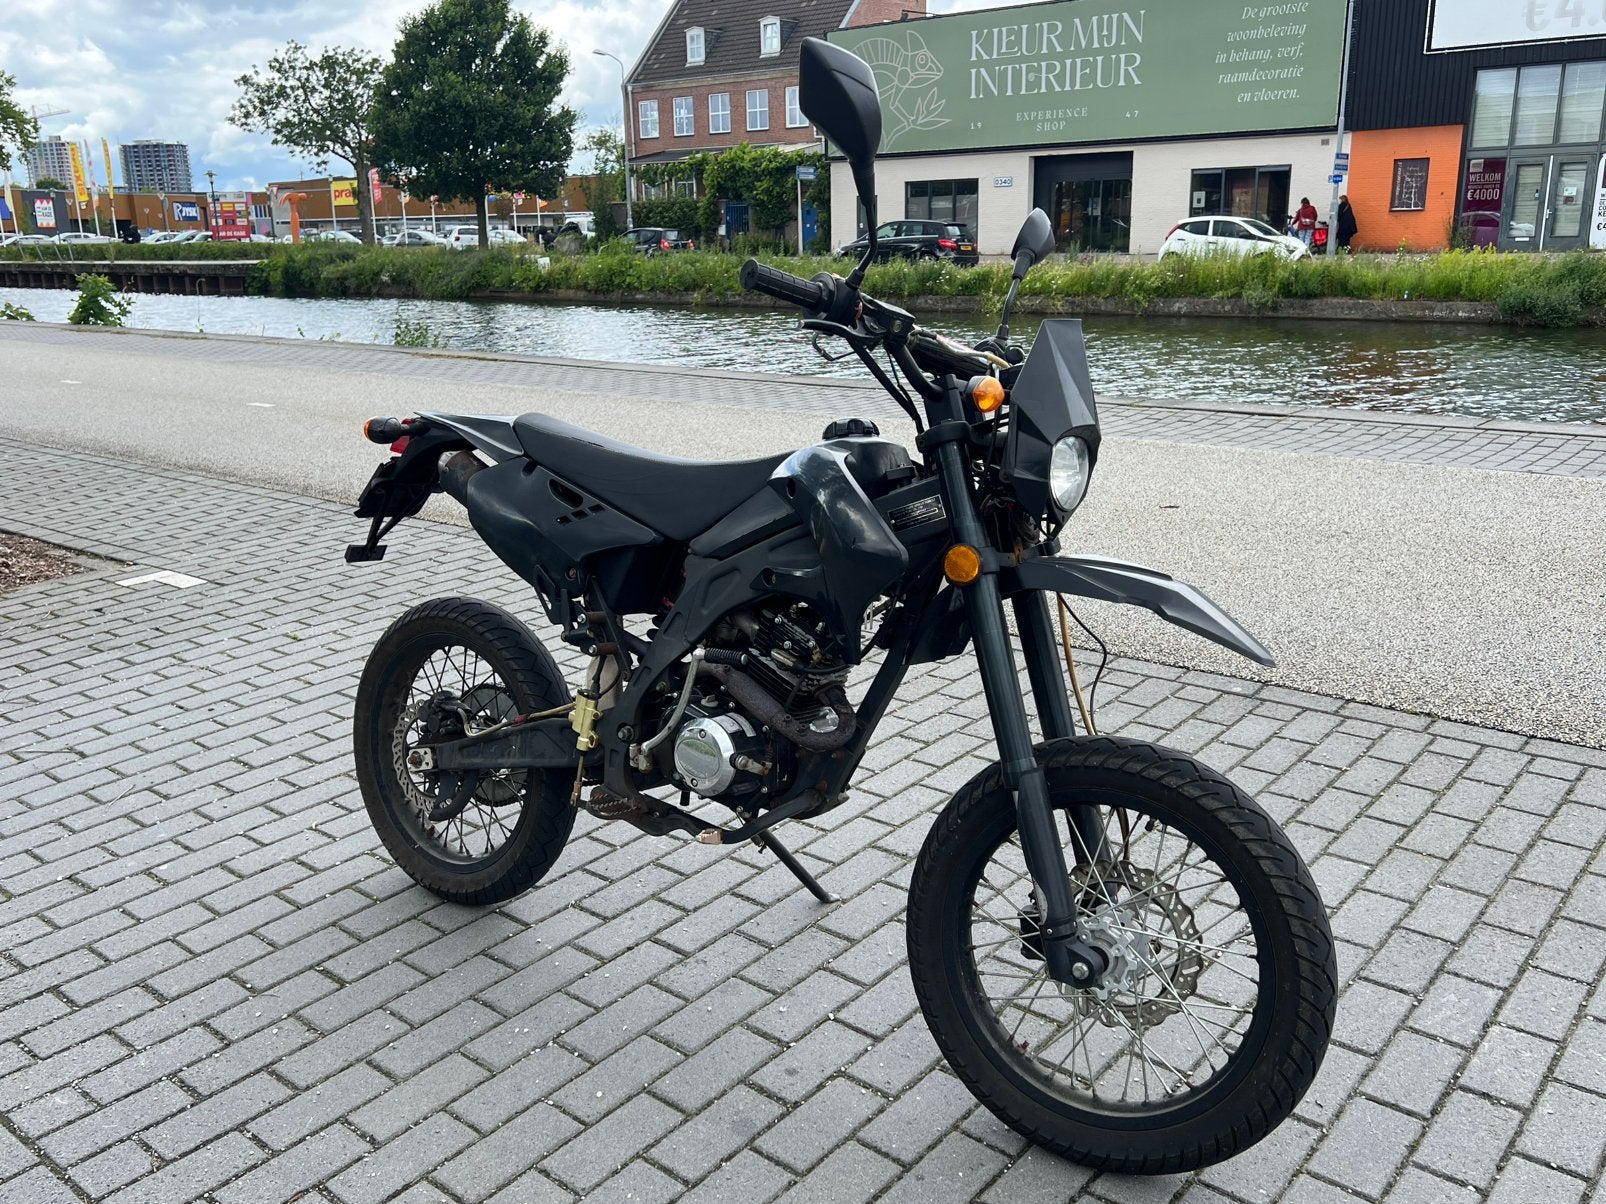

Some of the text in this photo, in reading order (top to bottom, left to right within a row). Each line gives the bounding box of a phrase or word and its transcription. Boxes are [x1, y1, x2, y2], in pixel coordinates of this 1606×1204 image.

[1241, 1, 1309, 21] De grootste
[1520, 0, 1606, 32] €4.
[970, 10, 1146, 61] KLEUR MIJN
[1227, 22, 1307, 42] woonbeleving
[1215, 42, 1305, 64] in behang, verf,
[969, 52, 1142, 99] INTERIEUR
[1218, 64, 1304, 84] raamdecoratie
[1237, 88, 1300, 103] en vloeren.
[1016, 107, 1088, 121] EXPERIENCE
[1036, 121, 1066, 131] SHOP
[1469, 173, 1501, 182] WELKOM
[1467, 189, 1500, 200] €4000
